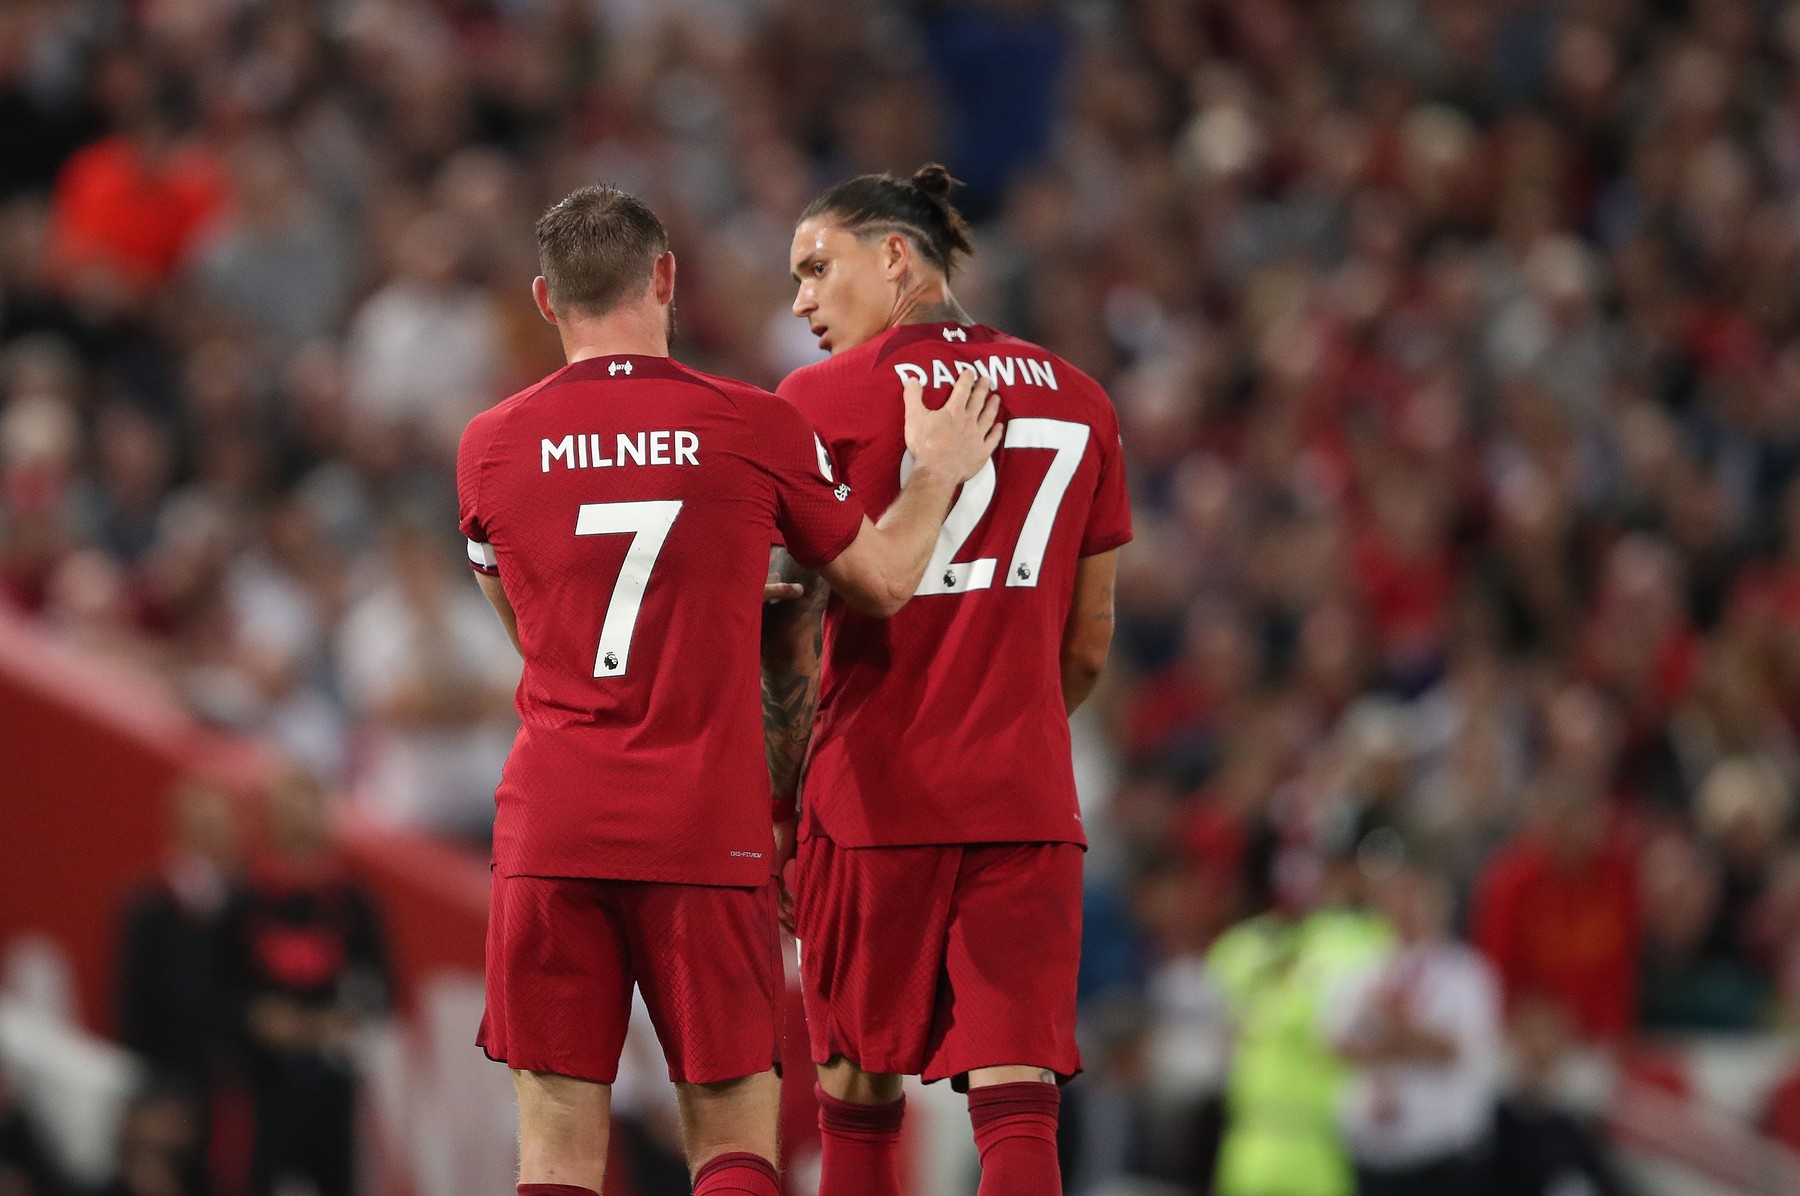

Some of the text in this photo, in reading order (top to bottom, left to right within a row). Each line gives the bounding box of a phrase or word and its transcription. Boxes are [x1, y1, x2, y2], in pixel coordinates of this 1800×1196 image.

[541, 430, 700, 474] MILNER
[899, 417, 1091, 597] 27
[574, 499, 684, 678] 7
